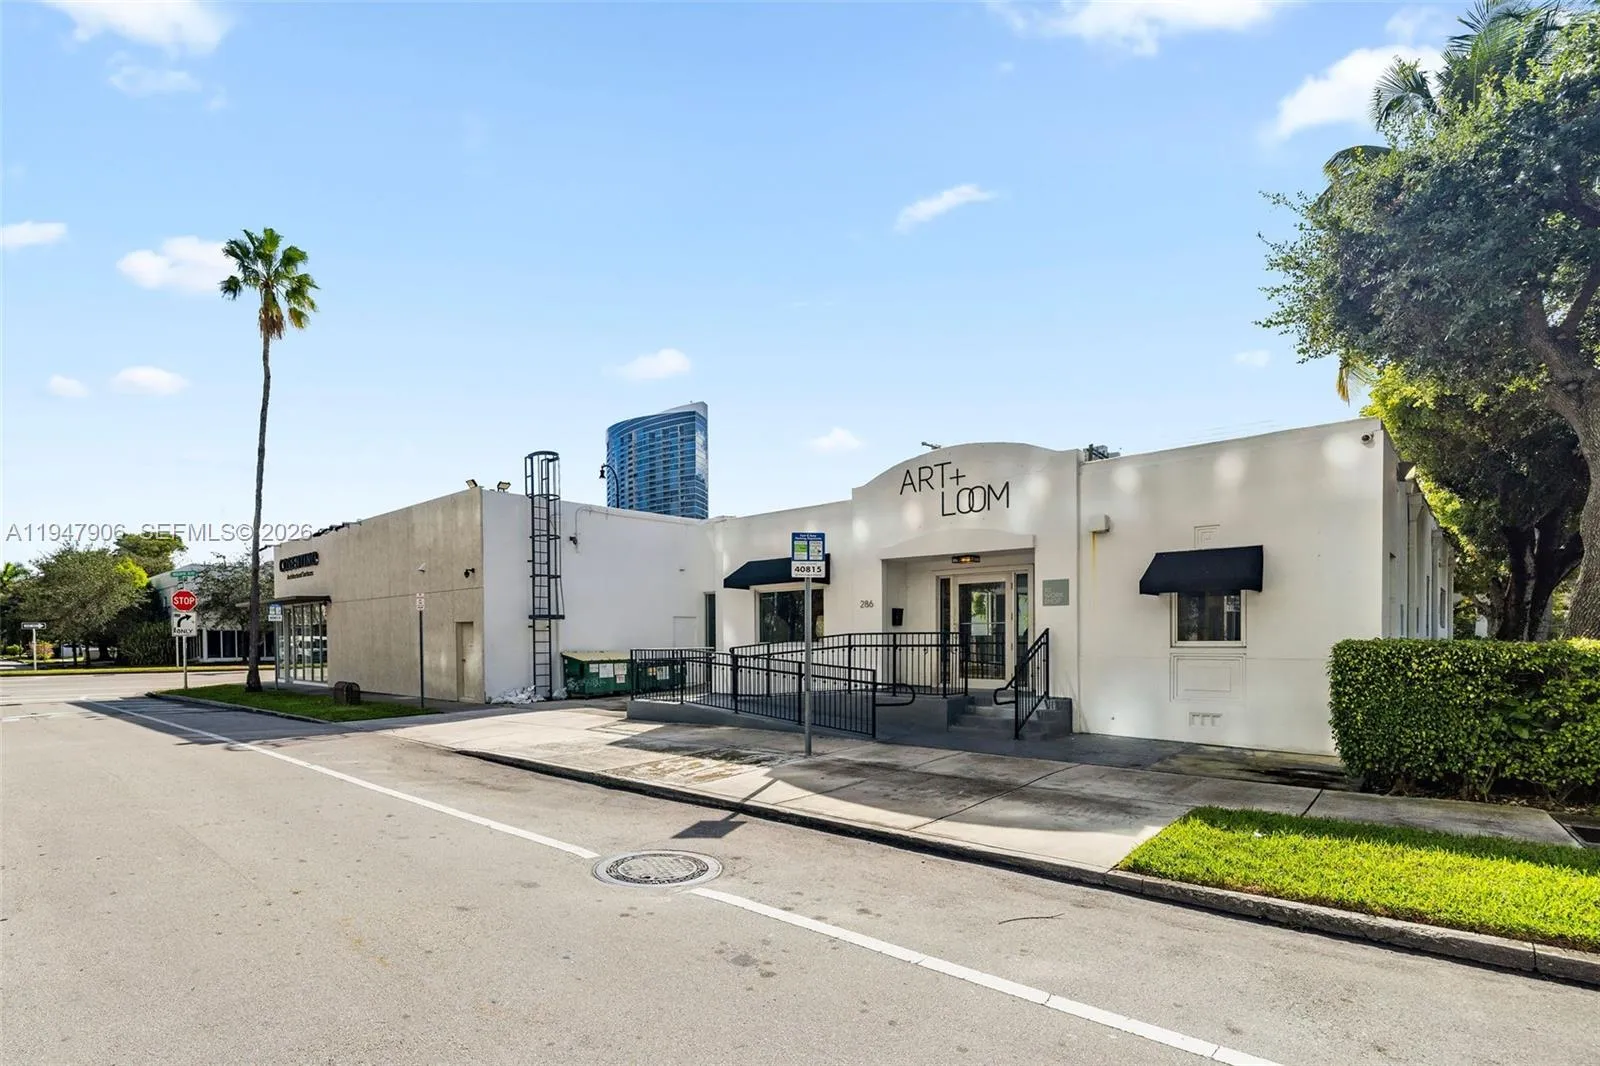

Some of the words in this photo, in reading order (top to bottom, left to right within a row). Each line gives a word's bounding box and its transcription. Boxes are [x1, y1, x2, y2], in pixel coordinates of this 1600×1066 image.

[900, 461, 966, 495] ART+
[941, 481, 1010, 517] LOOM
[794, 565, 822, 574] 40815
[173, 596, 195, 605] STOP
[860, 599, 874, 609] 286
